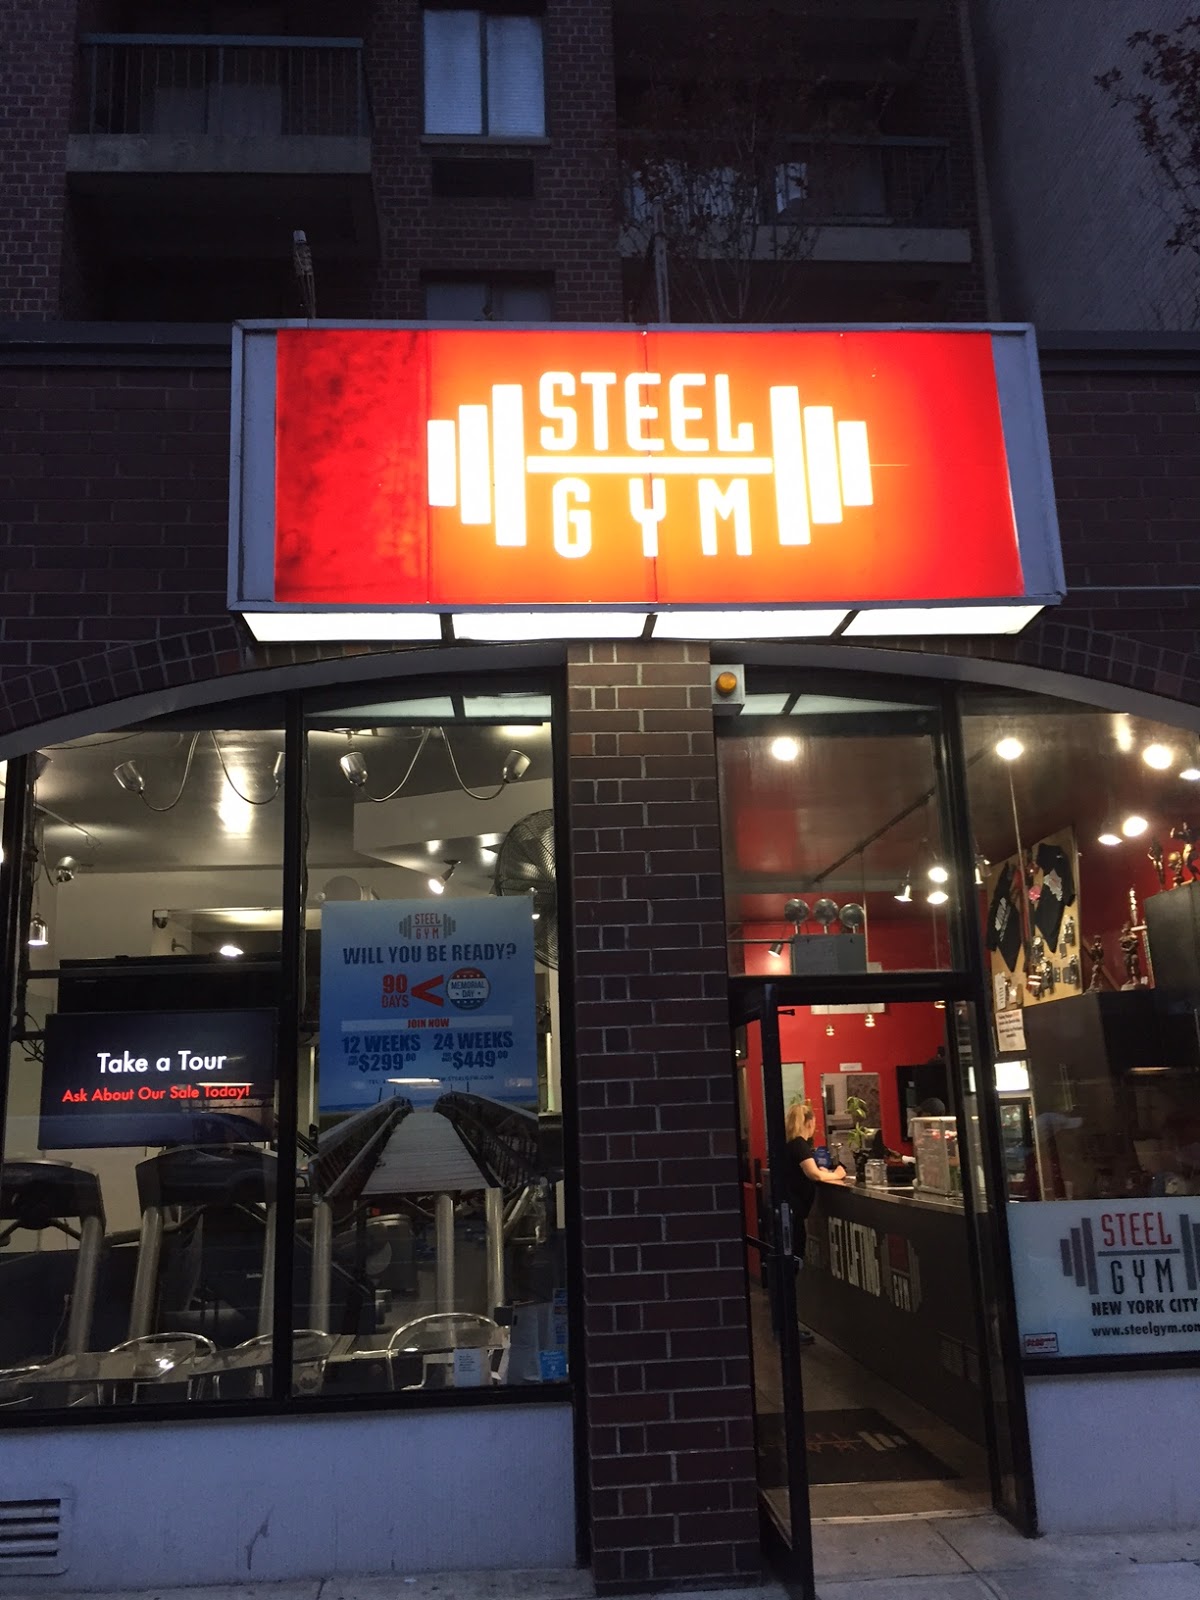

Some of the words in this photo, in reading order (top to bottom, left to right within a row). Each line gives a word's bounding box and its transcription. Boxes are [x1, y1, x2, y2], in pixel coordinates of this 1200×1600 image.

[539, 371, 755, 452] STEEL
[552, 477, 753, 558] GYM
[414, 913, 441, 925] STEEL
[415, 927, 439, 939] GYM
[343, 947, 384, 965] WILL
[388, 945, 422, 963] YOU
[427, 944, 447, 962] BE
[452, 942, 517, 961] READY?
[382, 974, 408, 994] 90
[451, 980, 485, 990] MEMORIAL
[462, 989, 475, 998] DAY
[381, 995, 409, 1008] DAYS
[407, 1019, 427, 1029] JOIN
[428, 1018, 450, 1028] NOW
[342, 1036, 360, 1054] 12
[364, 1034, 421, 1052] WEEKS
[433, 1032, 454, 1050] 24
[457, 1031, 514, 1049] WEEKS
[97, 1051, 148, 1074] Take
[156, 1057, 171, 1072] a
[178, 1050, 227, 1071] Tour
[61, 1087, 88, 1102] Ask
[91, 1088, 135, 1101] About
[138, 1086, 166, 1100] Our
[170, 1085, 199, 1099] Sale
[203, 1085, 251, 1100] Today!
[1101, 1212, 1172, 1247] STEEL
[1110, 1258, 1174, 1295] GYM
[1091, 1301, 1122, 1316] NEW
[1127, 1299, 1165, 1314] YORK
[1169, 1298, 1199, 1312] CITY
